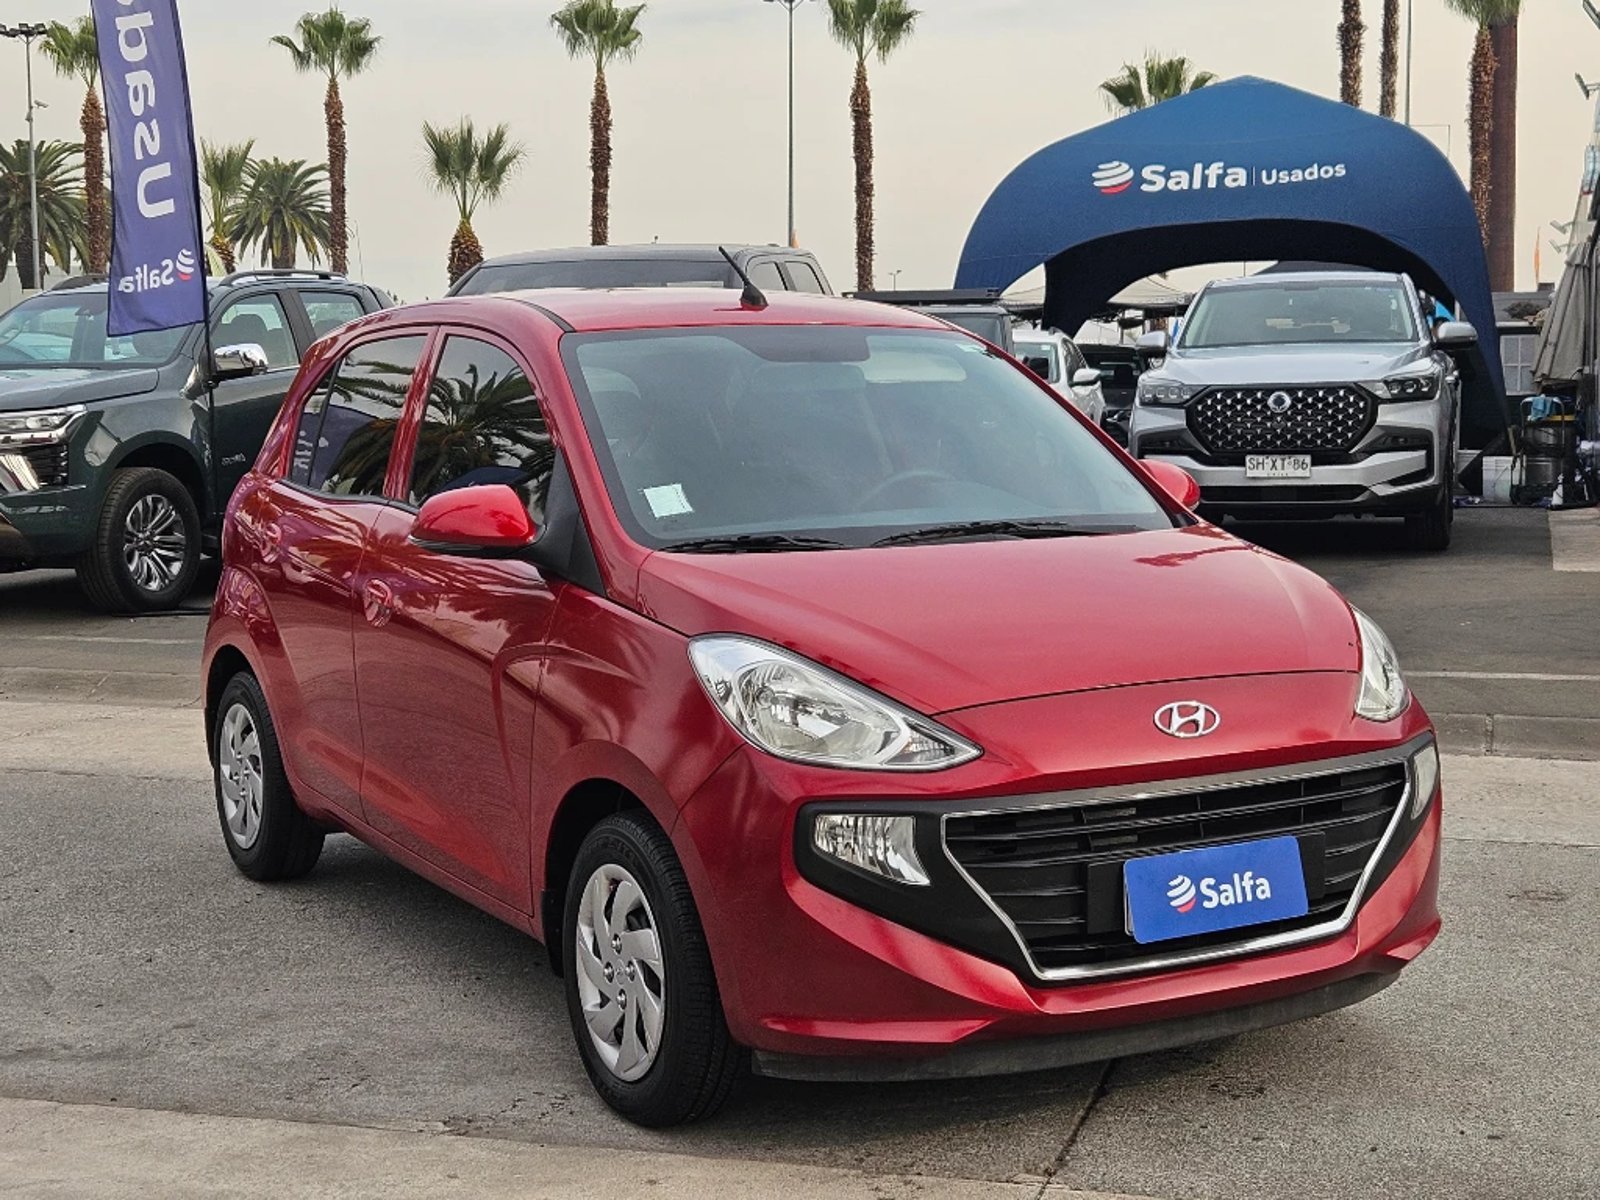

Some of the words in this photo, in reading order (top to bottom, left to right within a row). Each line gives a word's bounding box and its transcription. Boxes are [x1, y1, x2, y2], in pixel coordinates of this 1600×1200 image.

[1140, 162, 1248, 193] Salfa
[1261, 163, 1347, 185] Usados
[1199, 871, 1271, 909] Salfa
